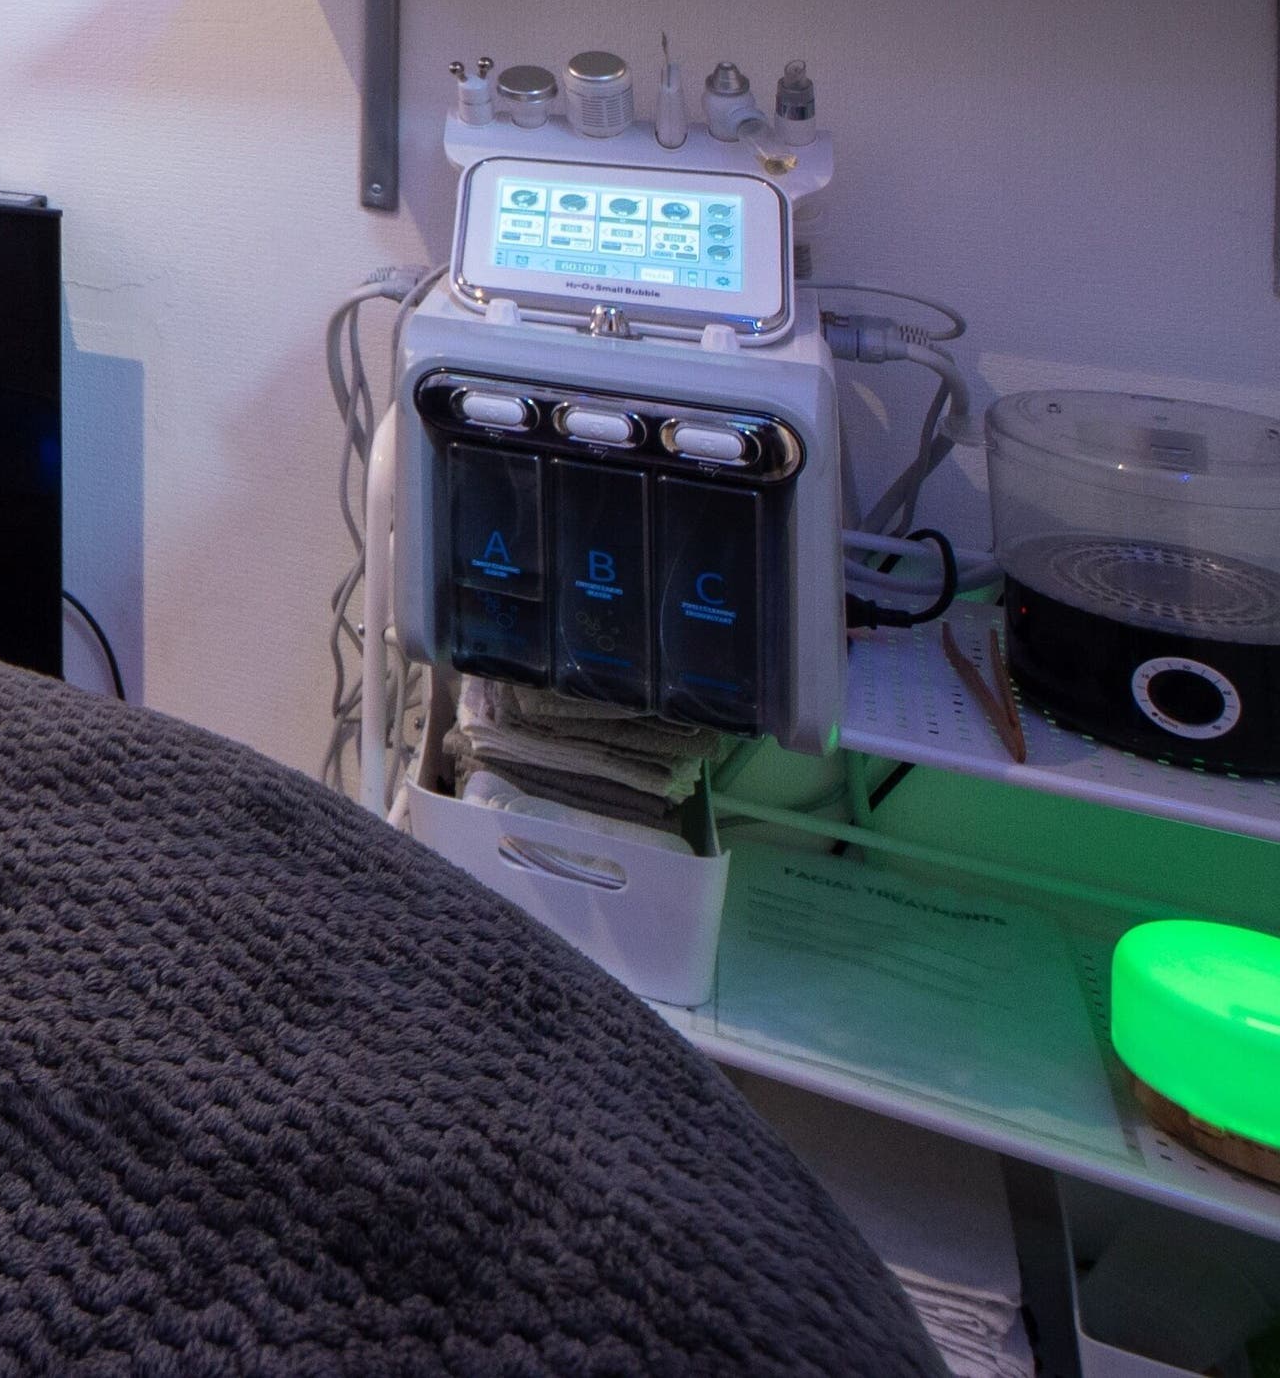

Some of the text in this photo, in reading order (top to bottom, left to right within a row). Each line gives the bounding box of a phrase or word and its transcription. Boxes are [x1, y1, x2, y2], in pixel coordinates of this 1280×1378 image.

[596, 284, 623, 293] Small
[625, 287, 660, 298] Bubble
[484, 531, 511, 563] A
[589, 550, 616, 582] B
[695, 573, 726, 605] C
[784, 867, 1008, 925] FACIAL TREATMENTS
